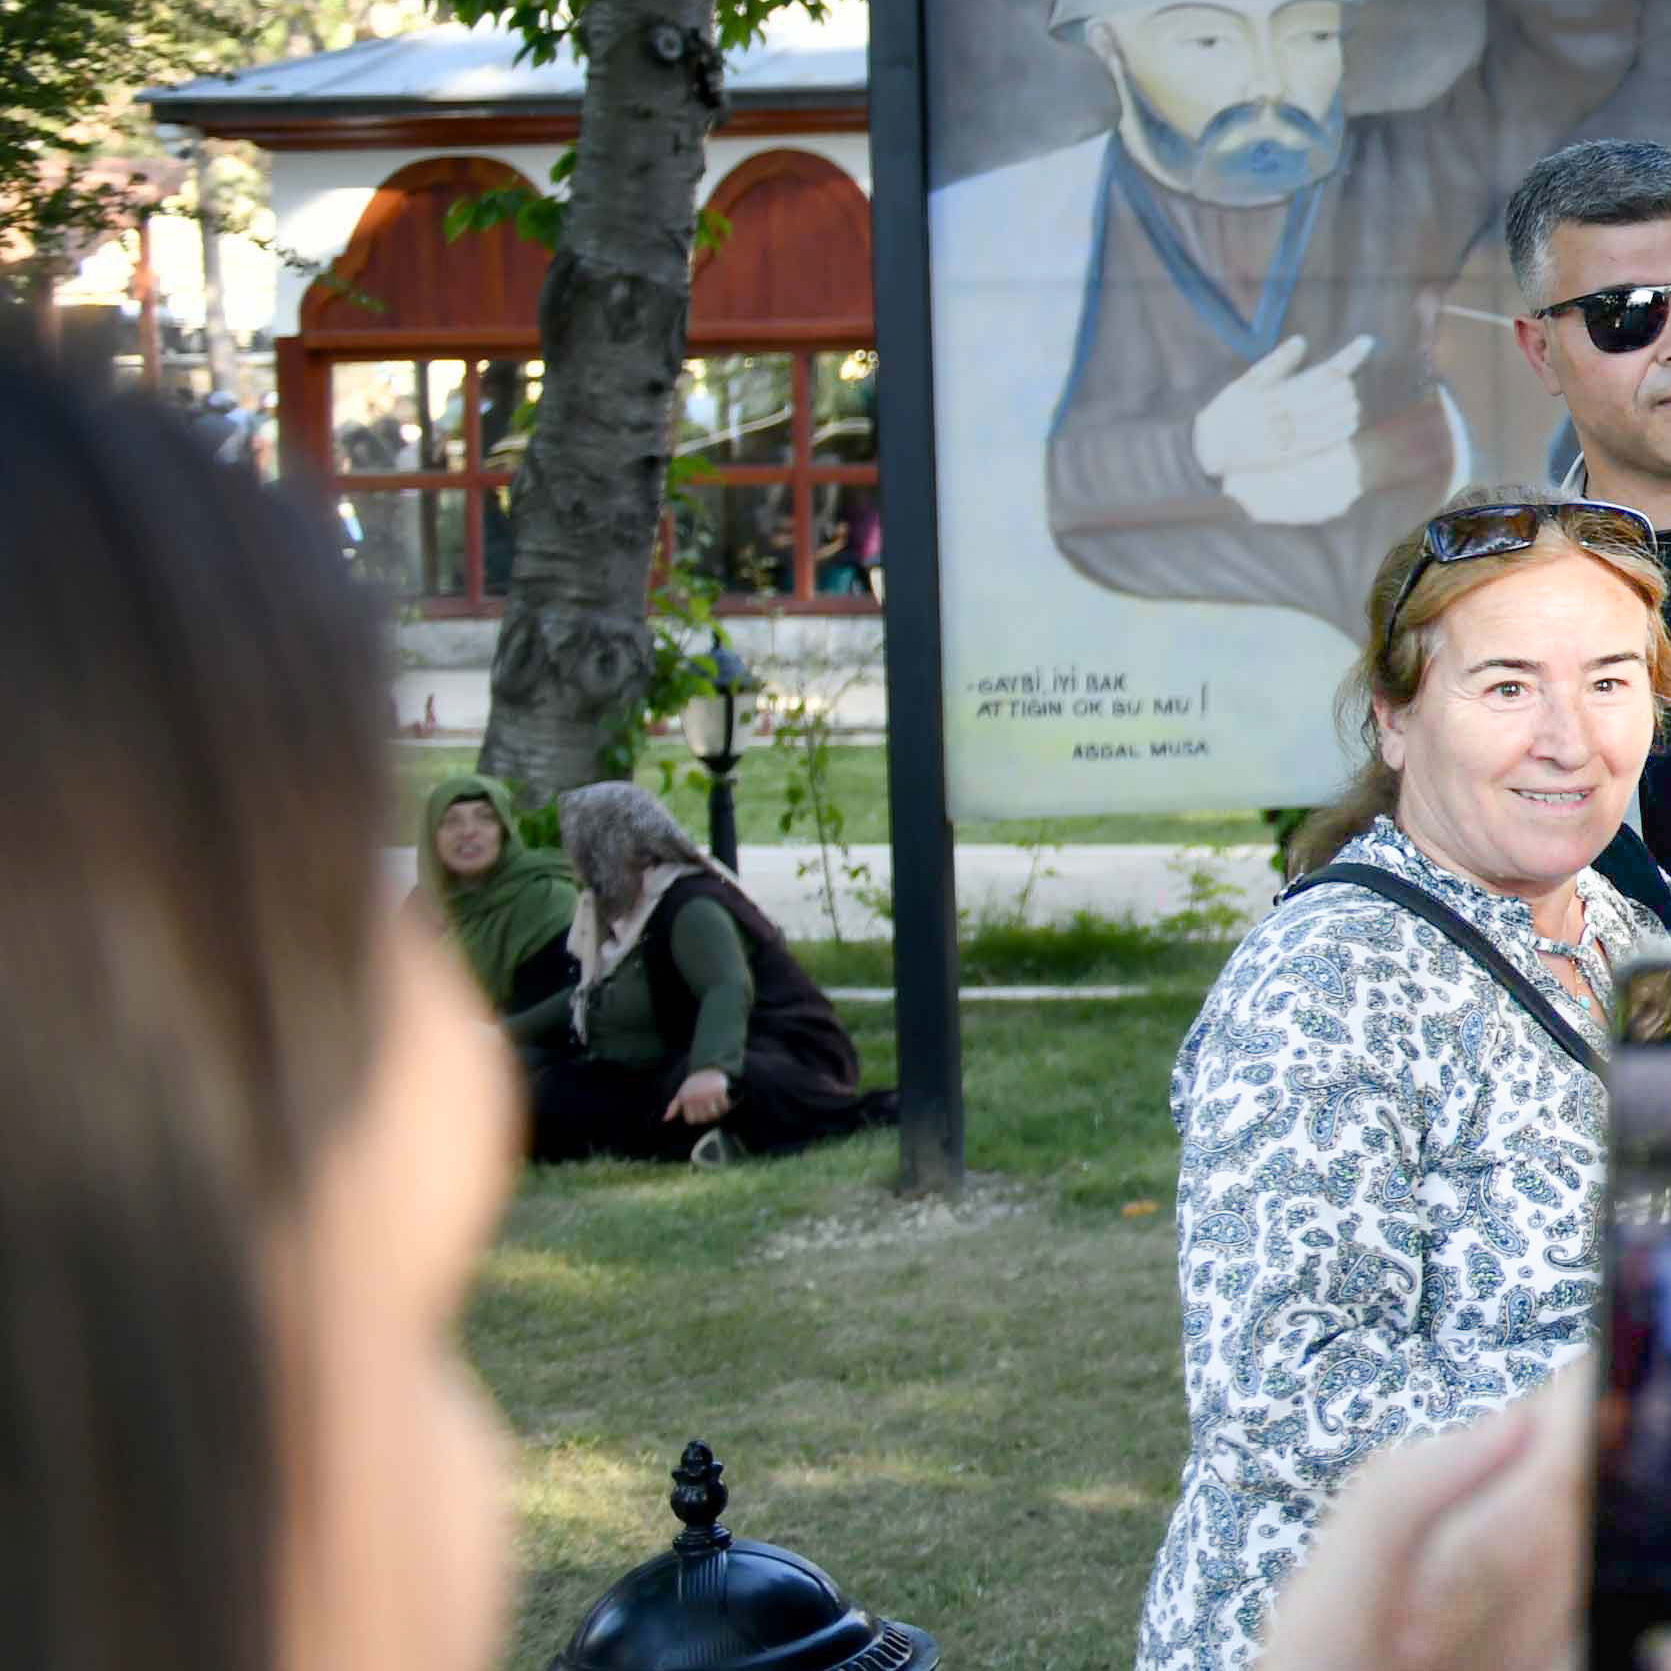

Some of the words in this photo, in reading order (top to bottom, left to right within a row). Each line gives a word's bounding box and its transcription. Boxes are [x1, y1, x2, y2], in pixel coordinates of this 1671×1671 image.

[1085, 673, 1127, 693] BAK
[1073, 699, 1104, 717] OK
[1112, 699, 1142, 717] BU
[1072, 741, 1140, 761] ABDAL
[1150, 739, 1210, 758] MUSA
